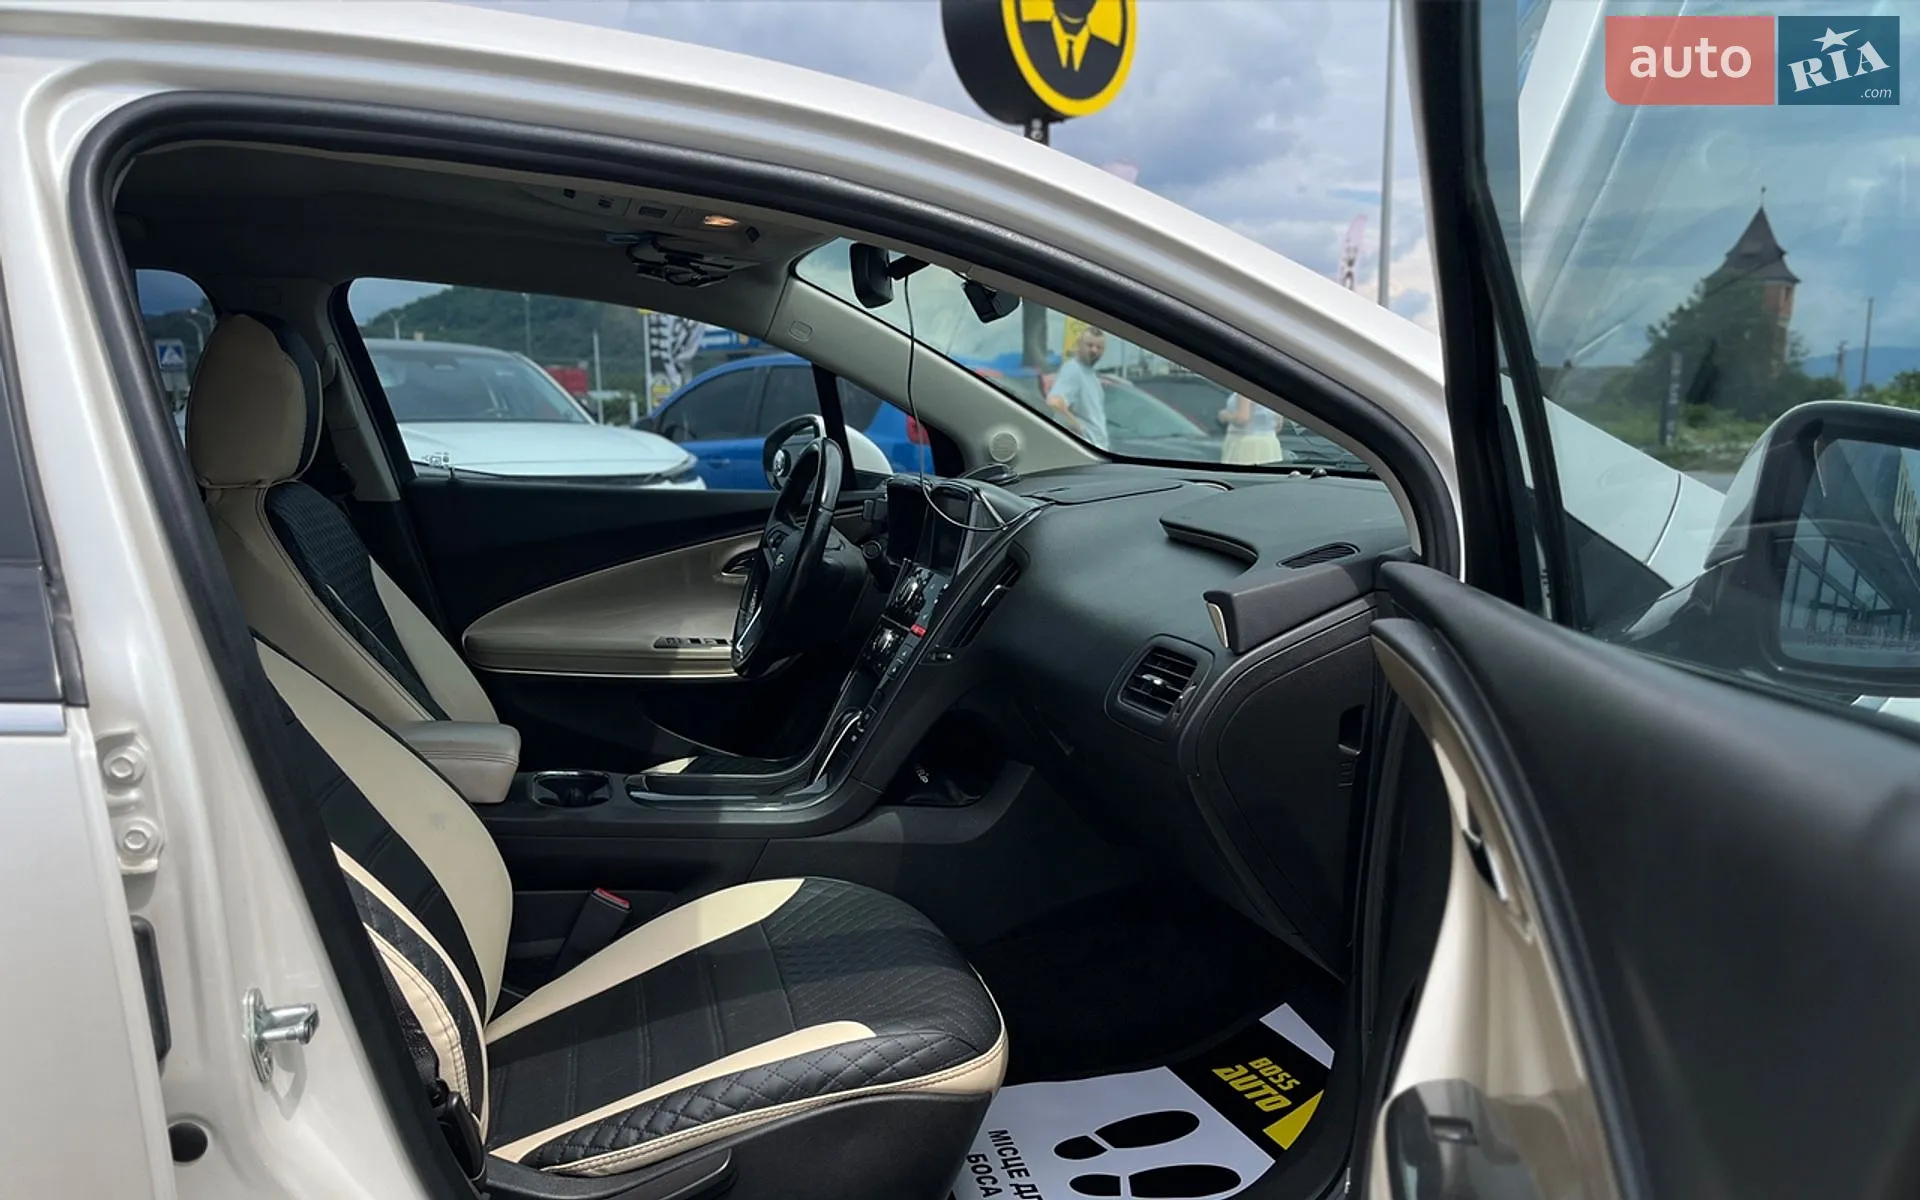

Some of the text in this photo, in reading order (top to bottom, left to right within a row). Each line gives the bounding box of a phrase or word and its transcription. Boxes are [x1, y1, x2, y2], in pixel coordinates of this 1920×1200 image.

[1211, 1064, 1293, 1112] AUTO
[1248, 1057, 1301, 1091] BOSS
[966, 1153, 1003, 1198] БОСА
[988, 1129, 1031, 1179] МІСЦЕ
